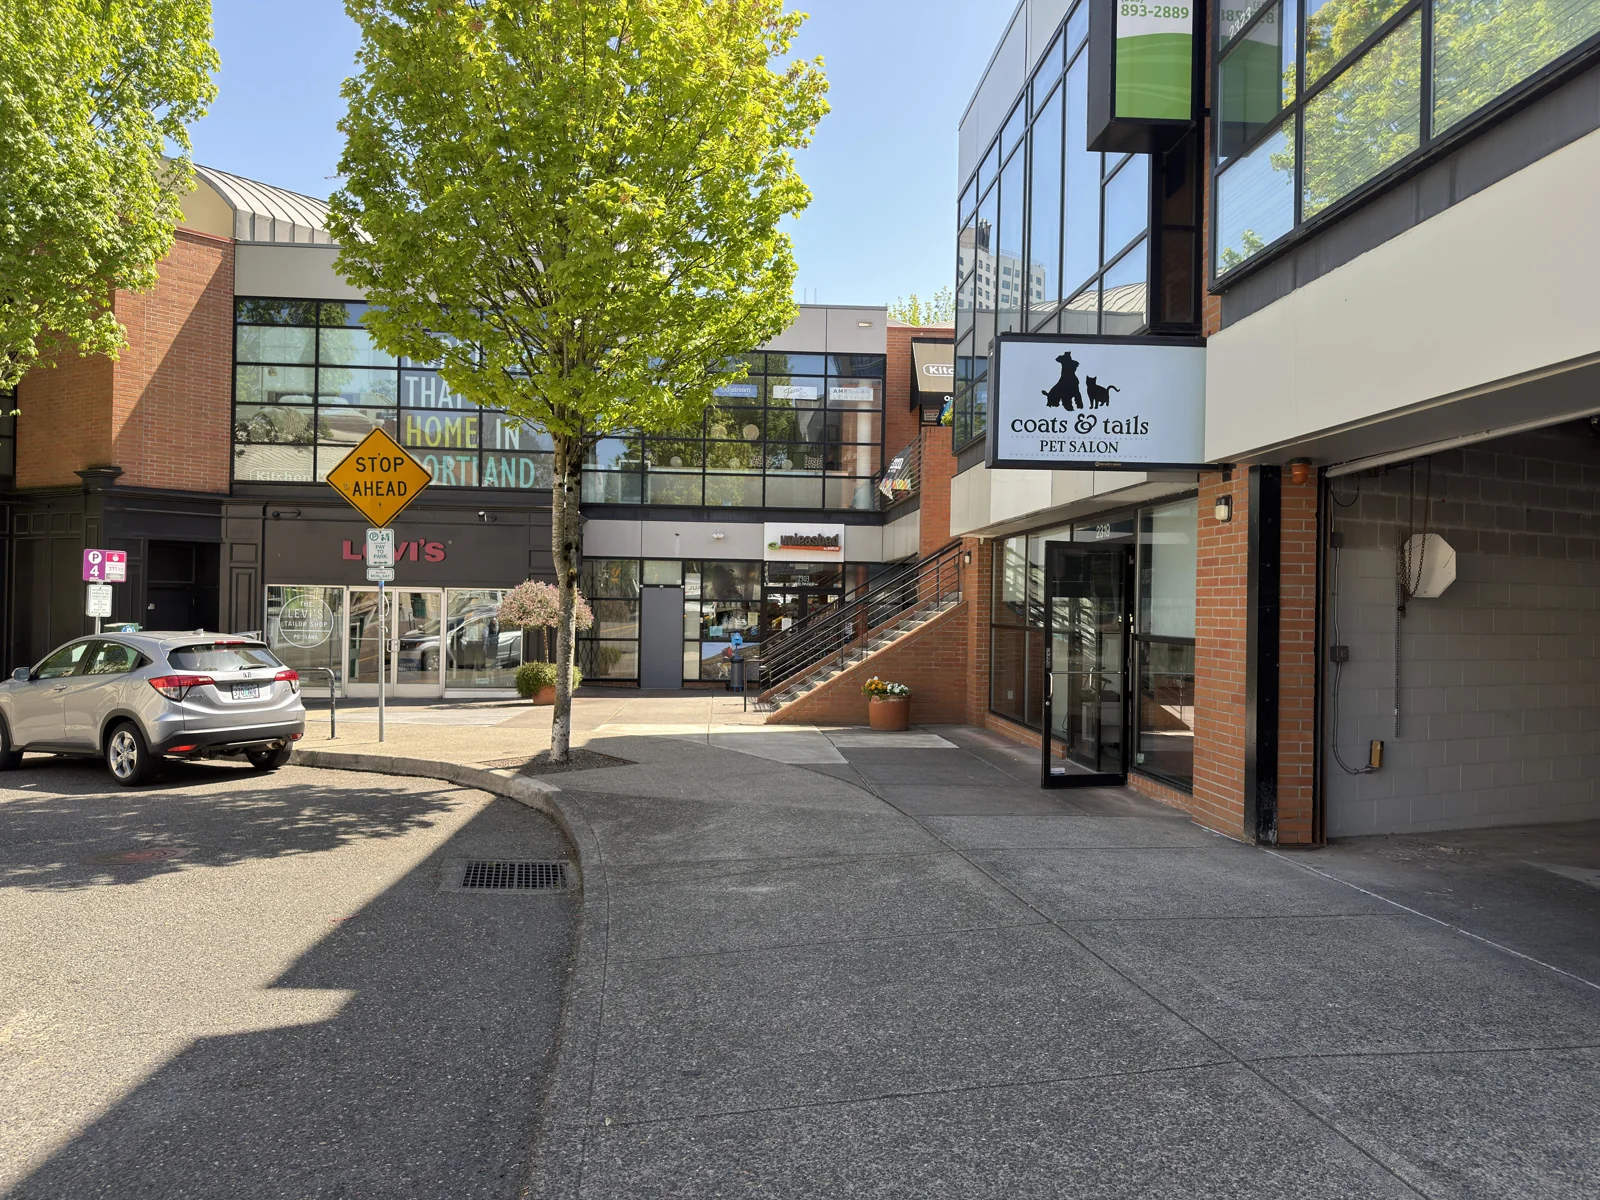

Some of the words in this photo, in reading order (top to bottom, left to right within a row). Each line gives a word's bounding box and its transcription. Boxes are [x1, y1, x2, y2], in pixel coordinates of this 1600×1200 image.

[1120, 4, 1189, 19] 893-2889
[1010, 416, 1068, 434] coats
[1074, 413, 1098, 434] &
[1102, 415, 1149, 434] tails
[406, 415, 478, 448] HOME
[496, 418, 520, 450] IN
[1040, 440, 1066, 452] PET
[1069, 441, 1119, 454] SALON
[356, 456, 404, 472] STOP
[256, 471, 311, 482] Kitchen
[352, 480, 407, 496] AHEAD
[780, 532, 840, 546] unleashed
[342, 538, 446, 562] LVI'S
[92, 553, 100, 562] P
[90, 564, 99, 576] 4
[287, 608, 324, 619] LEVI'S
